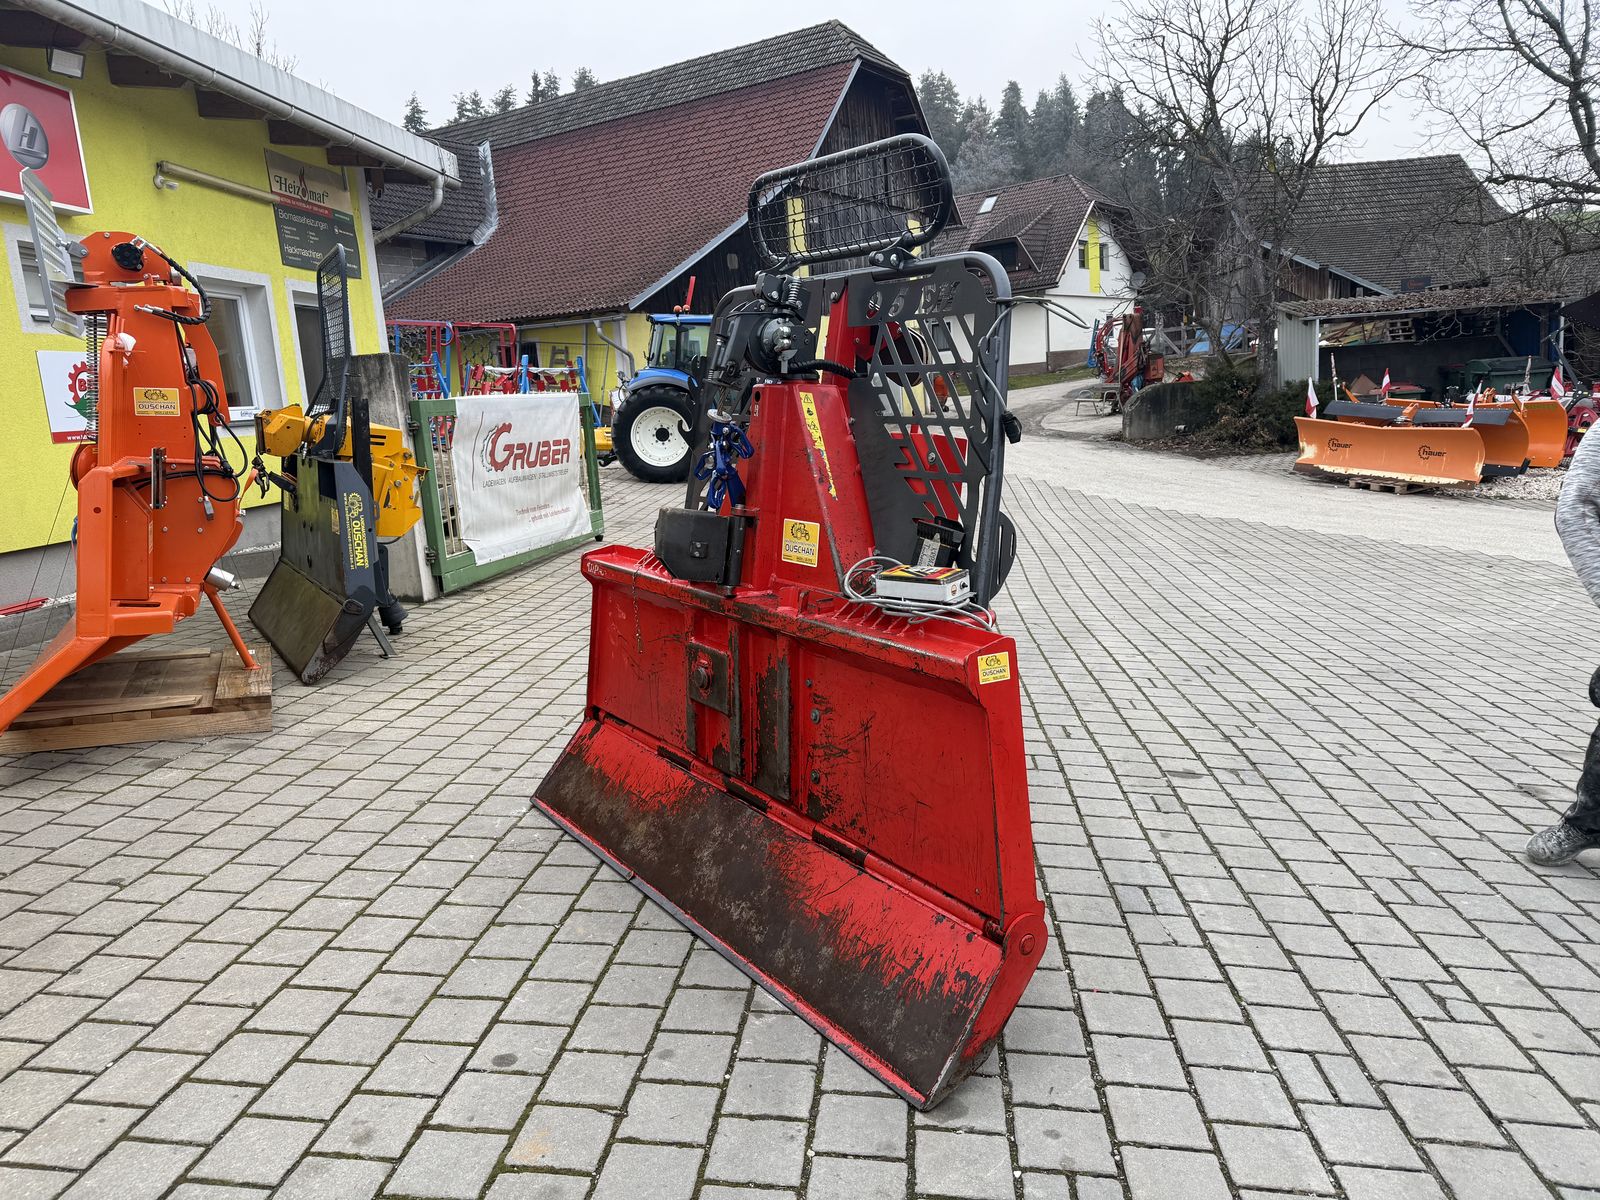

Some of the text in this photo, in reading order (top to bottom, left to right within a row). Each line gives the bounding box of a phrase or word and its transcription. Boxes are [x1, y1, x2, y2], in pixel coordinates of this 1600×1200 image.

[278, 208, 329, 231] Biomasseheizungen
[283, 242, 323, 260] Hackmaschinen
[488, 422, 571, 472] GRUBER
[1331, 440, 1353, 449] hauer
[1422, 448, 1447, 457] hauer
[352, 520, 365, 567] OUSCHAN
[785, 543, 815, 556] OUSCHAN
[982, 668, 1006, 677] OUSCHAN
